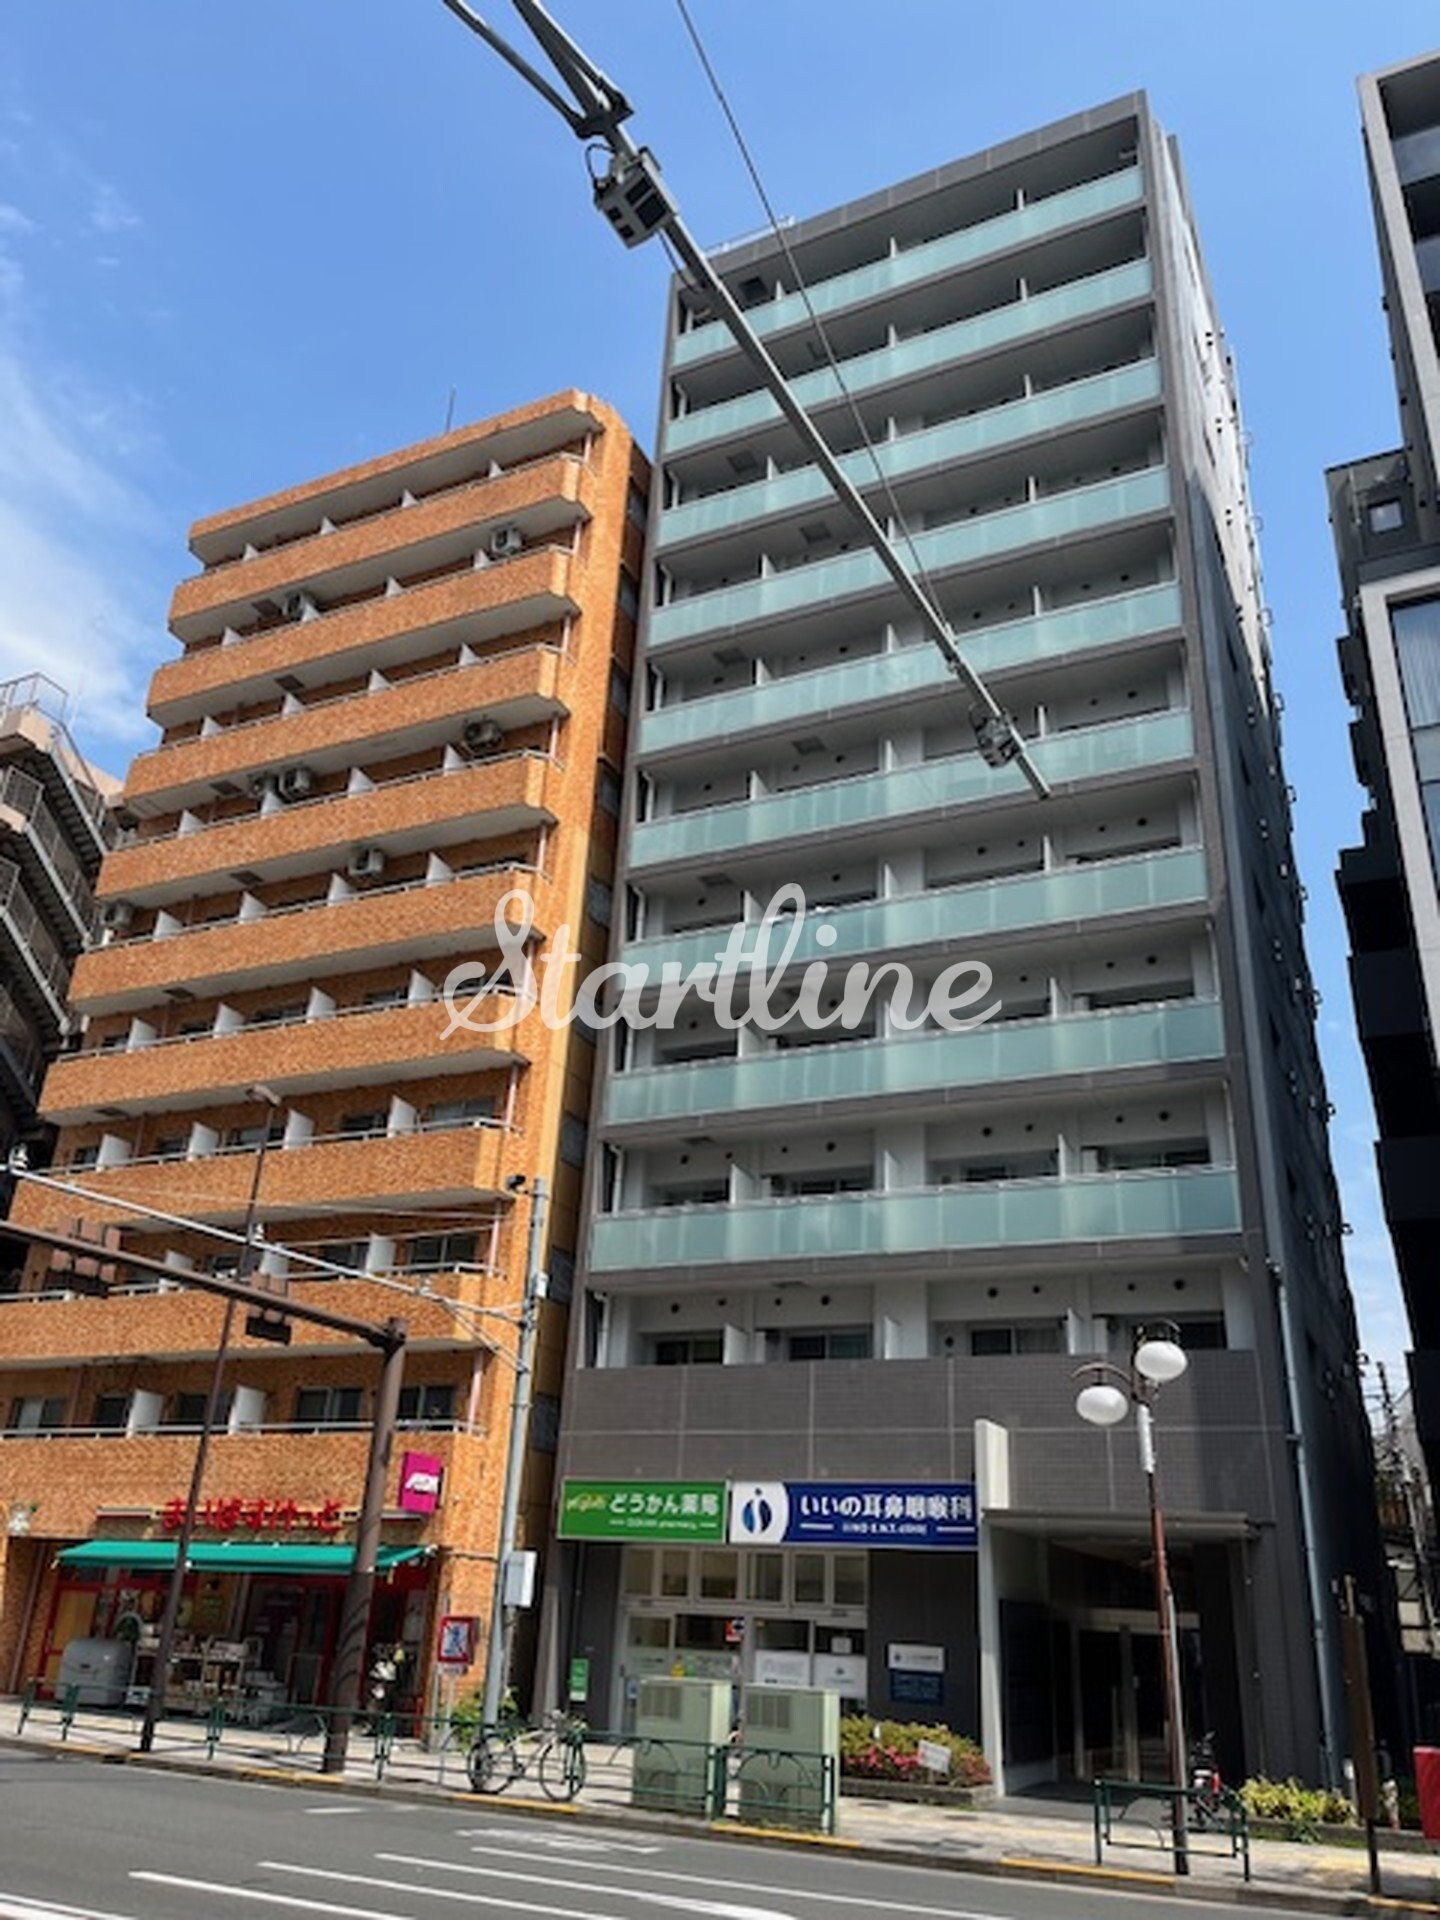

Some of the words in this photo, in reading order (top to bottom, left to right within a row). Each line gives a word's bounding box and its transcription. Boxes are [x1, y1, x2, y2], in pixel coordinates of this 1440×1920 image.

[609, 1493, 719, 1515] どうかん薬局
[801, 1494, 972, 1520] いいの耳鼻咽喉科
